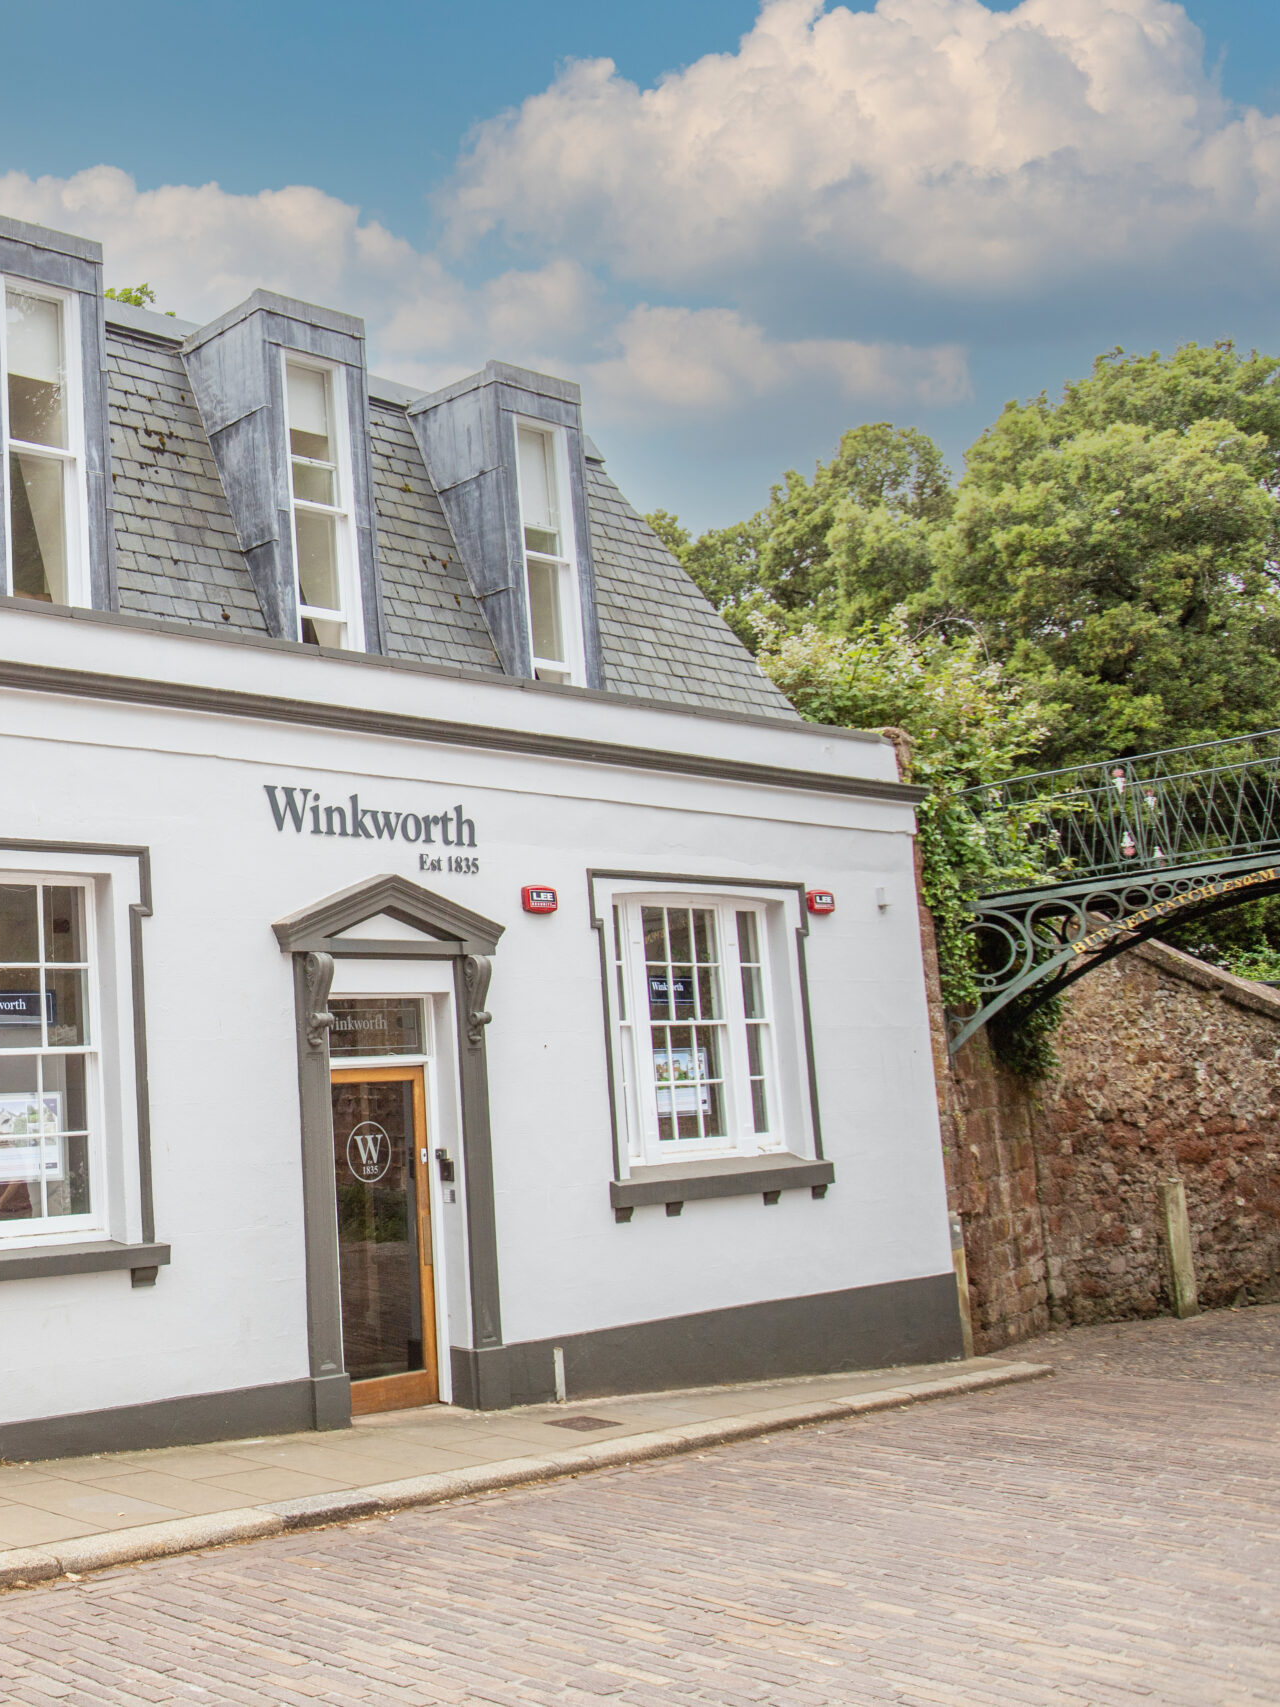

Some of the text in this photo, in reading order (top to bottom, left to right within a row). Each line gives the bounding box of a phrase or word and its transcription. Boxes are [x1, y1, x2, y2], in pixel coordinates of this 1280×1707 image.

[263, 784, 478, 848] Winkworth
[419, 853, 480, 874] Est 1835
[532, 891, 554, 901] LEE
[815, 895, 833, 904] LEE
[1152, 883, 1218, 916] PATCH
[353, 1134, 383, 1165] W
[363, 1165, 379, 1175] 1835
